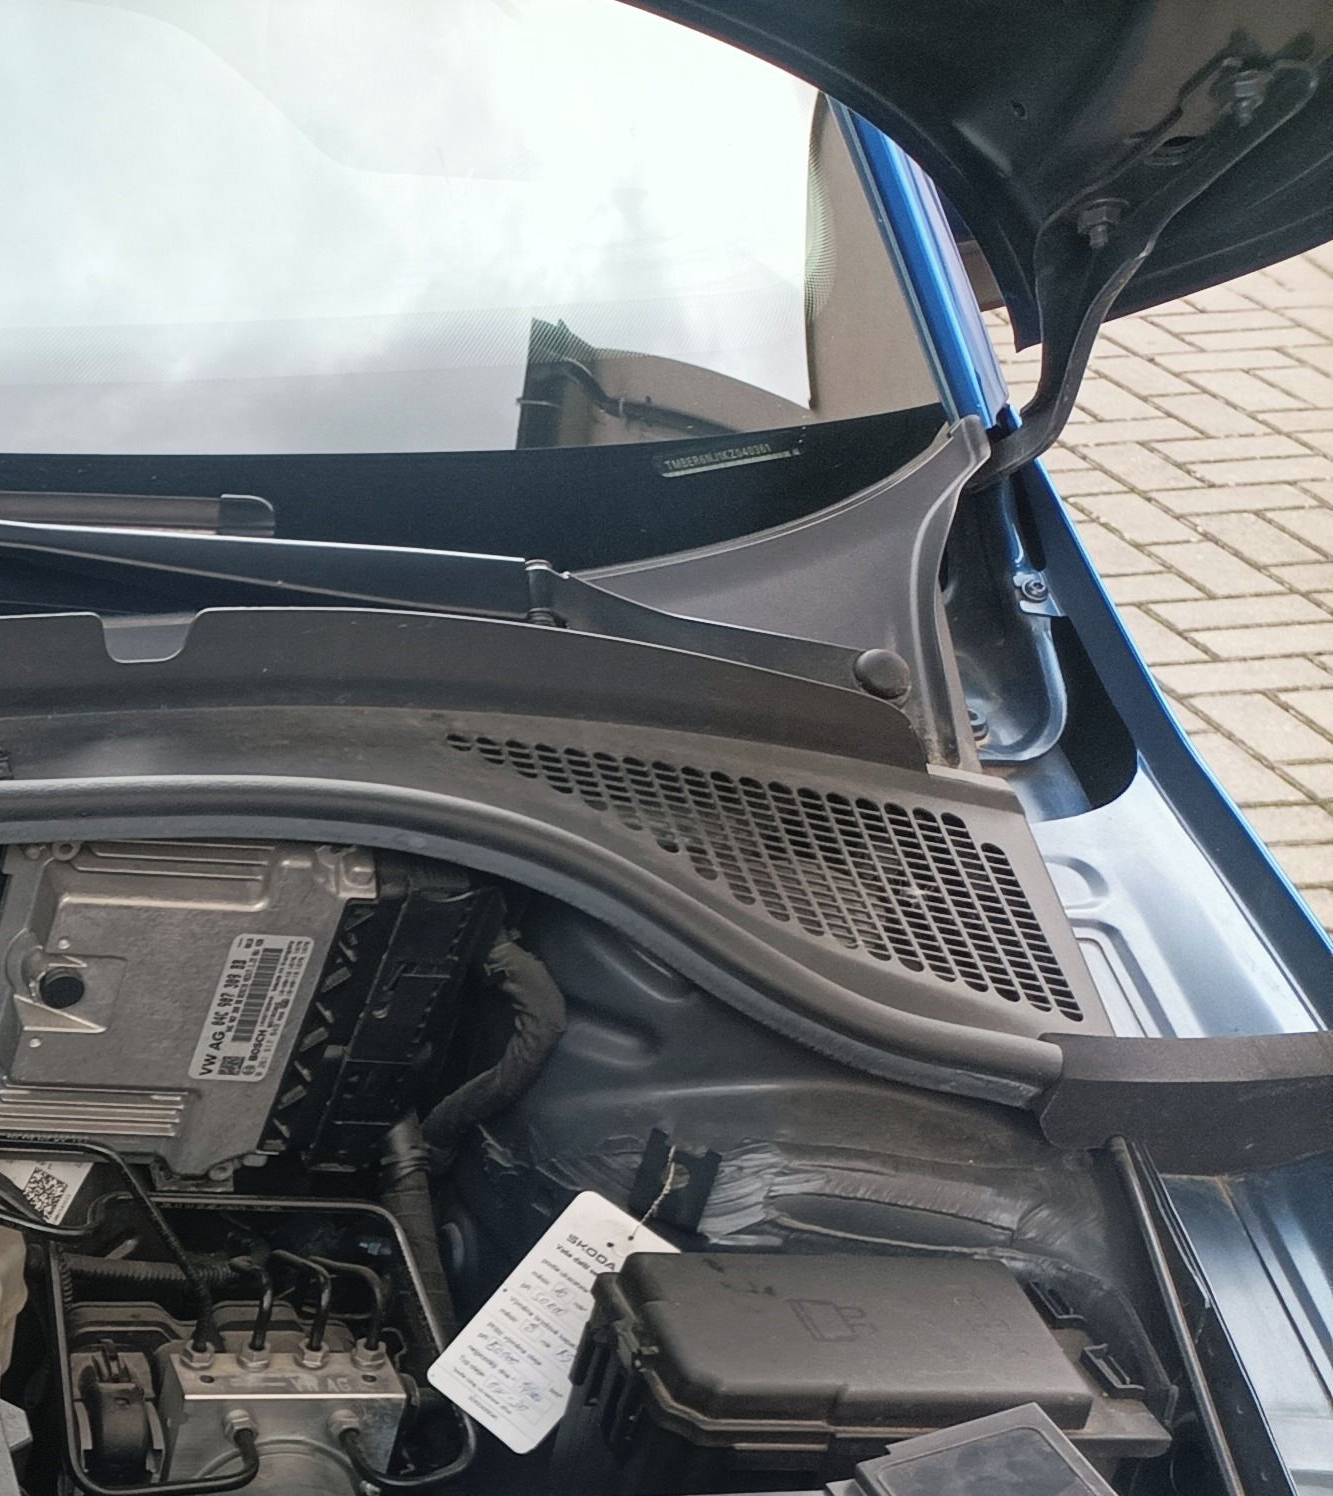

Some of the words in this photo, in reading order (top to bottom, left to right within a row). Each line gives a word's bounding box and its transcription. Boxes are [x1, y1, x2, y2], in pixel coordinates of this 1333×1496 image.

[198, 1055, 217, 1075] VW
[208, 1032, 226, 1047] AG
[248, 1030, 268, 1060] BOSCH
